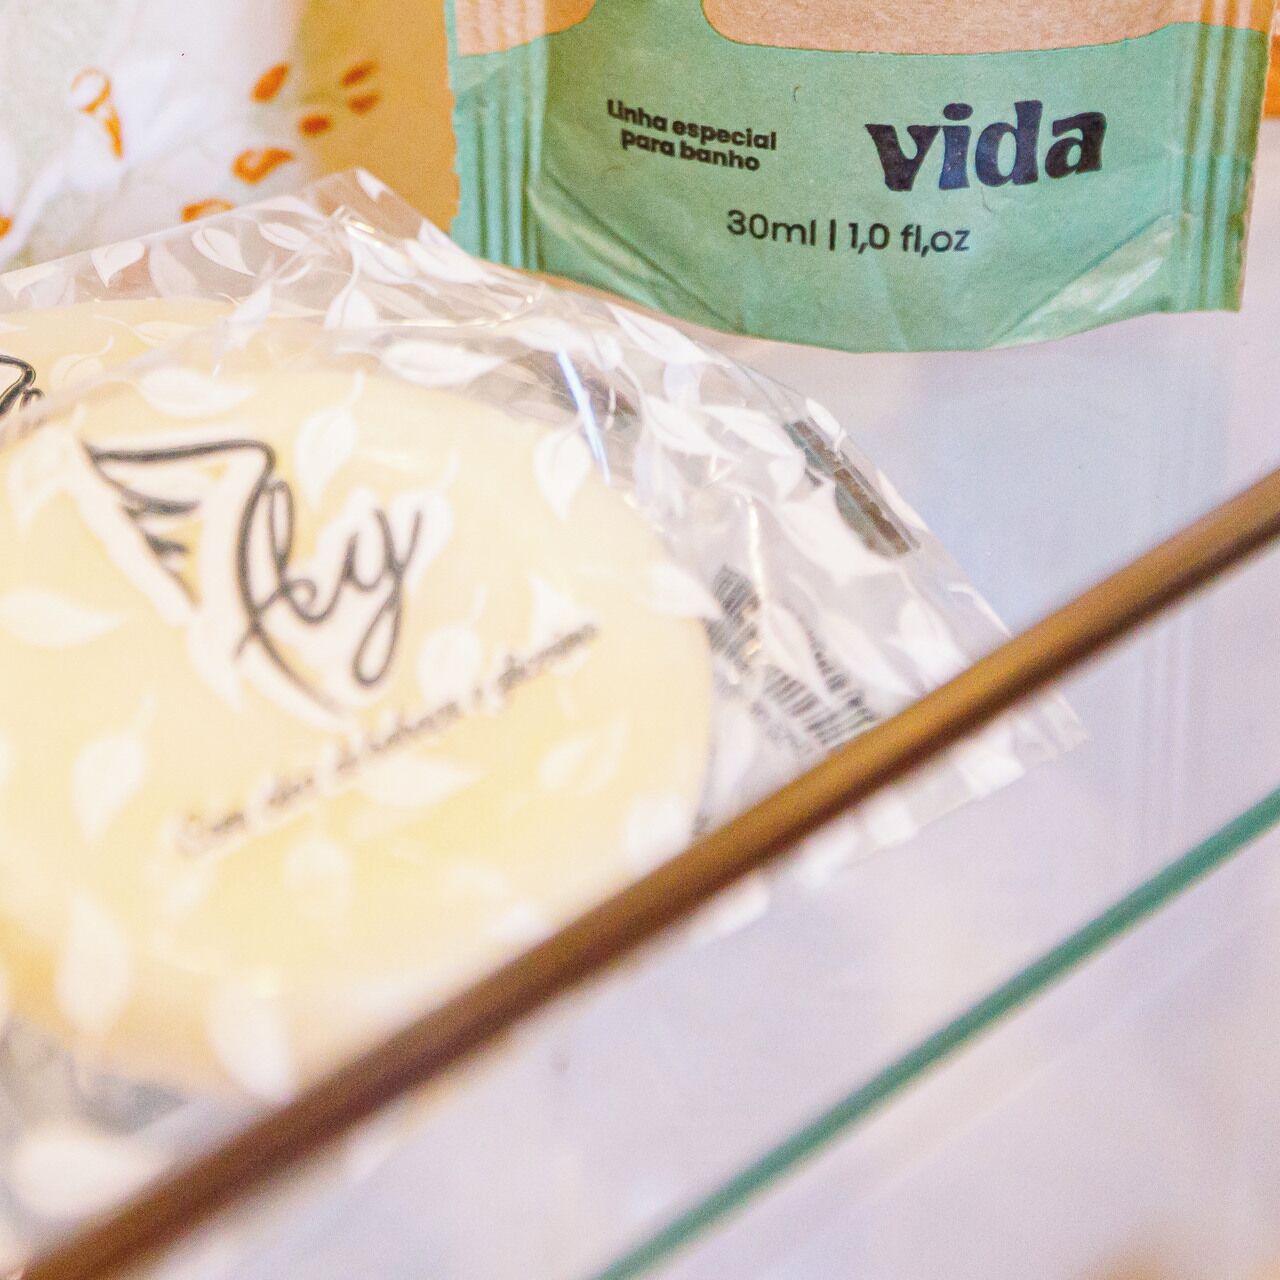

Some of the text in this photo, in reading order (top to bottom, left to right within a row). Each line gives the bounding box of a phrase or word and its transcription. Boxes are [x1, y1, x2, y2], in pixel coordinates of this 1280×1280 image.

[607, 99, 777, 151] Linha especial
[621, 128, 761, 171] para banho
[864, 99, 1108, 192] vida
[727, 209, 817, 246] 30ml
[848, 223, 890, 255] 1,0
[901, 224, 970, 258] fl,oz
